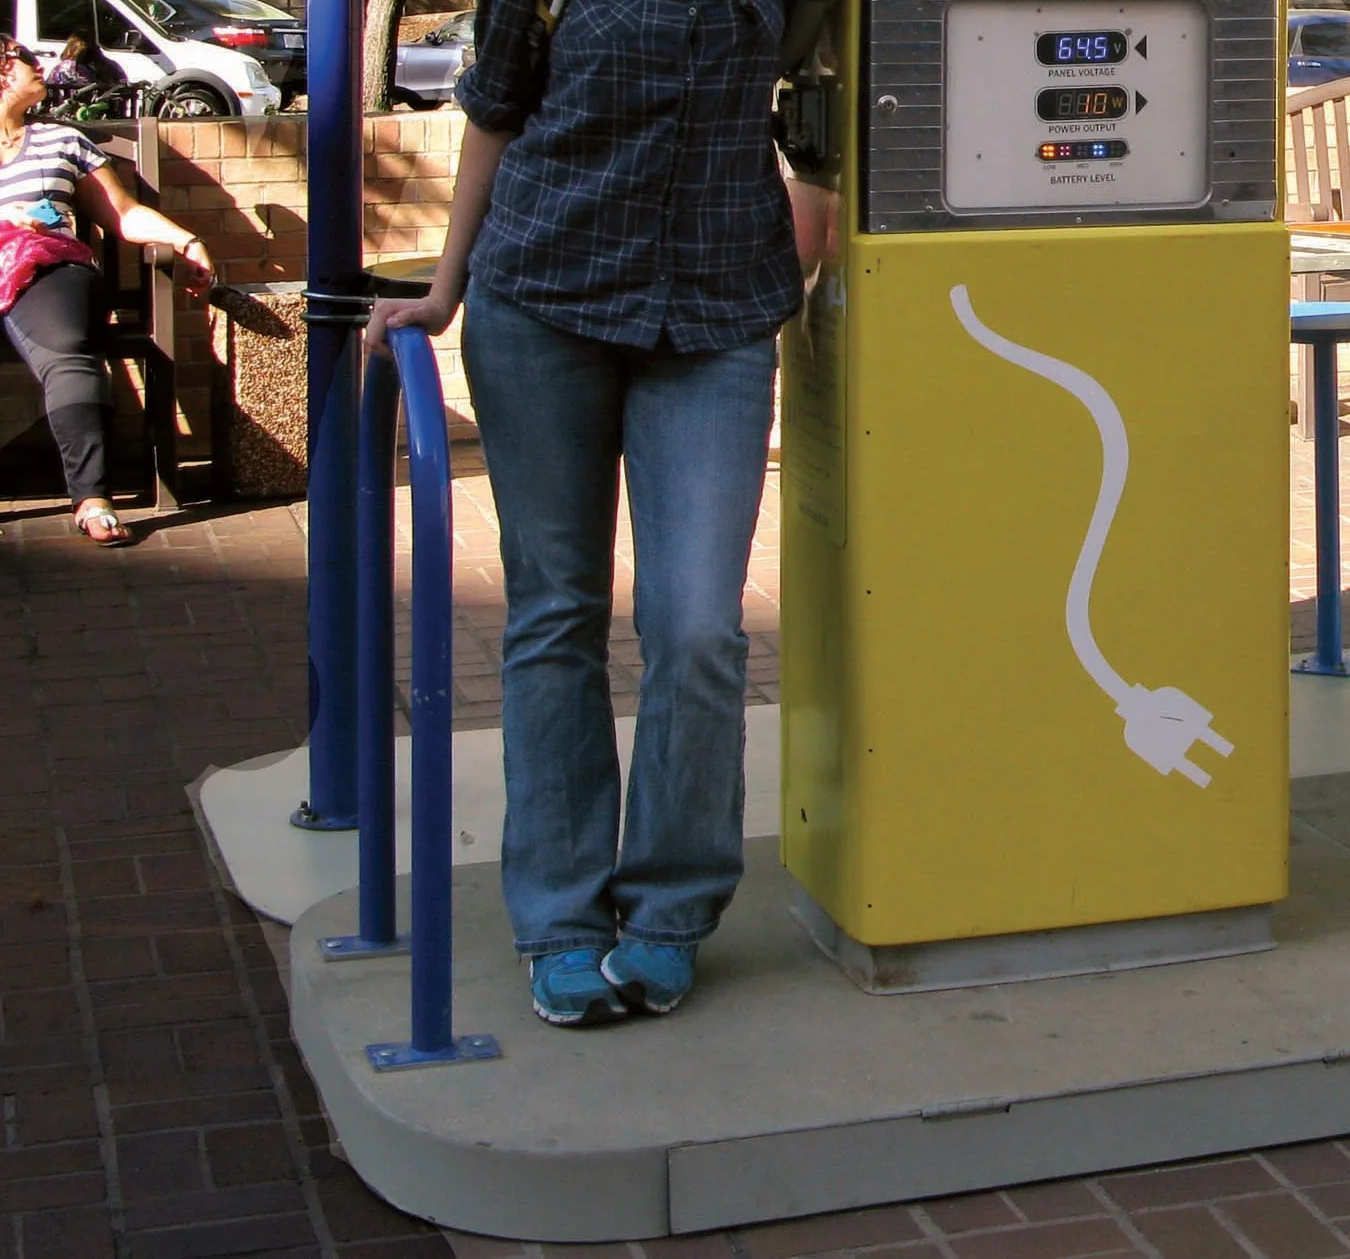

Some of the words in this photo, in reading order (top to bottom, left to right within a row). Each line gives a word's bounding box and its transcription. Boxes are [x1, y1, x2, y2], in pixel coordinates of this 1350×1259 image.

[1058, 36, 1108, 60] 64.5
[1112, 42, 1122, 54] V
[1048, 69, 1077, 78] PANEL
[1078, 67, 1117, 77] VOLTAGE
[1048, 124, 1081, 134] POWER
[1083, 123, 1117, 133] OUTPUT
[1050, 174, 1088, 185] BATTERY
[1090, 173, 1116, 183] LEVEL
